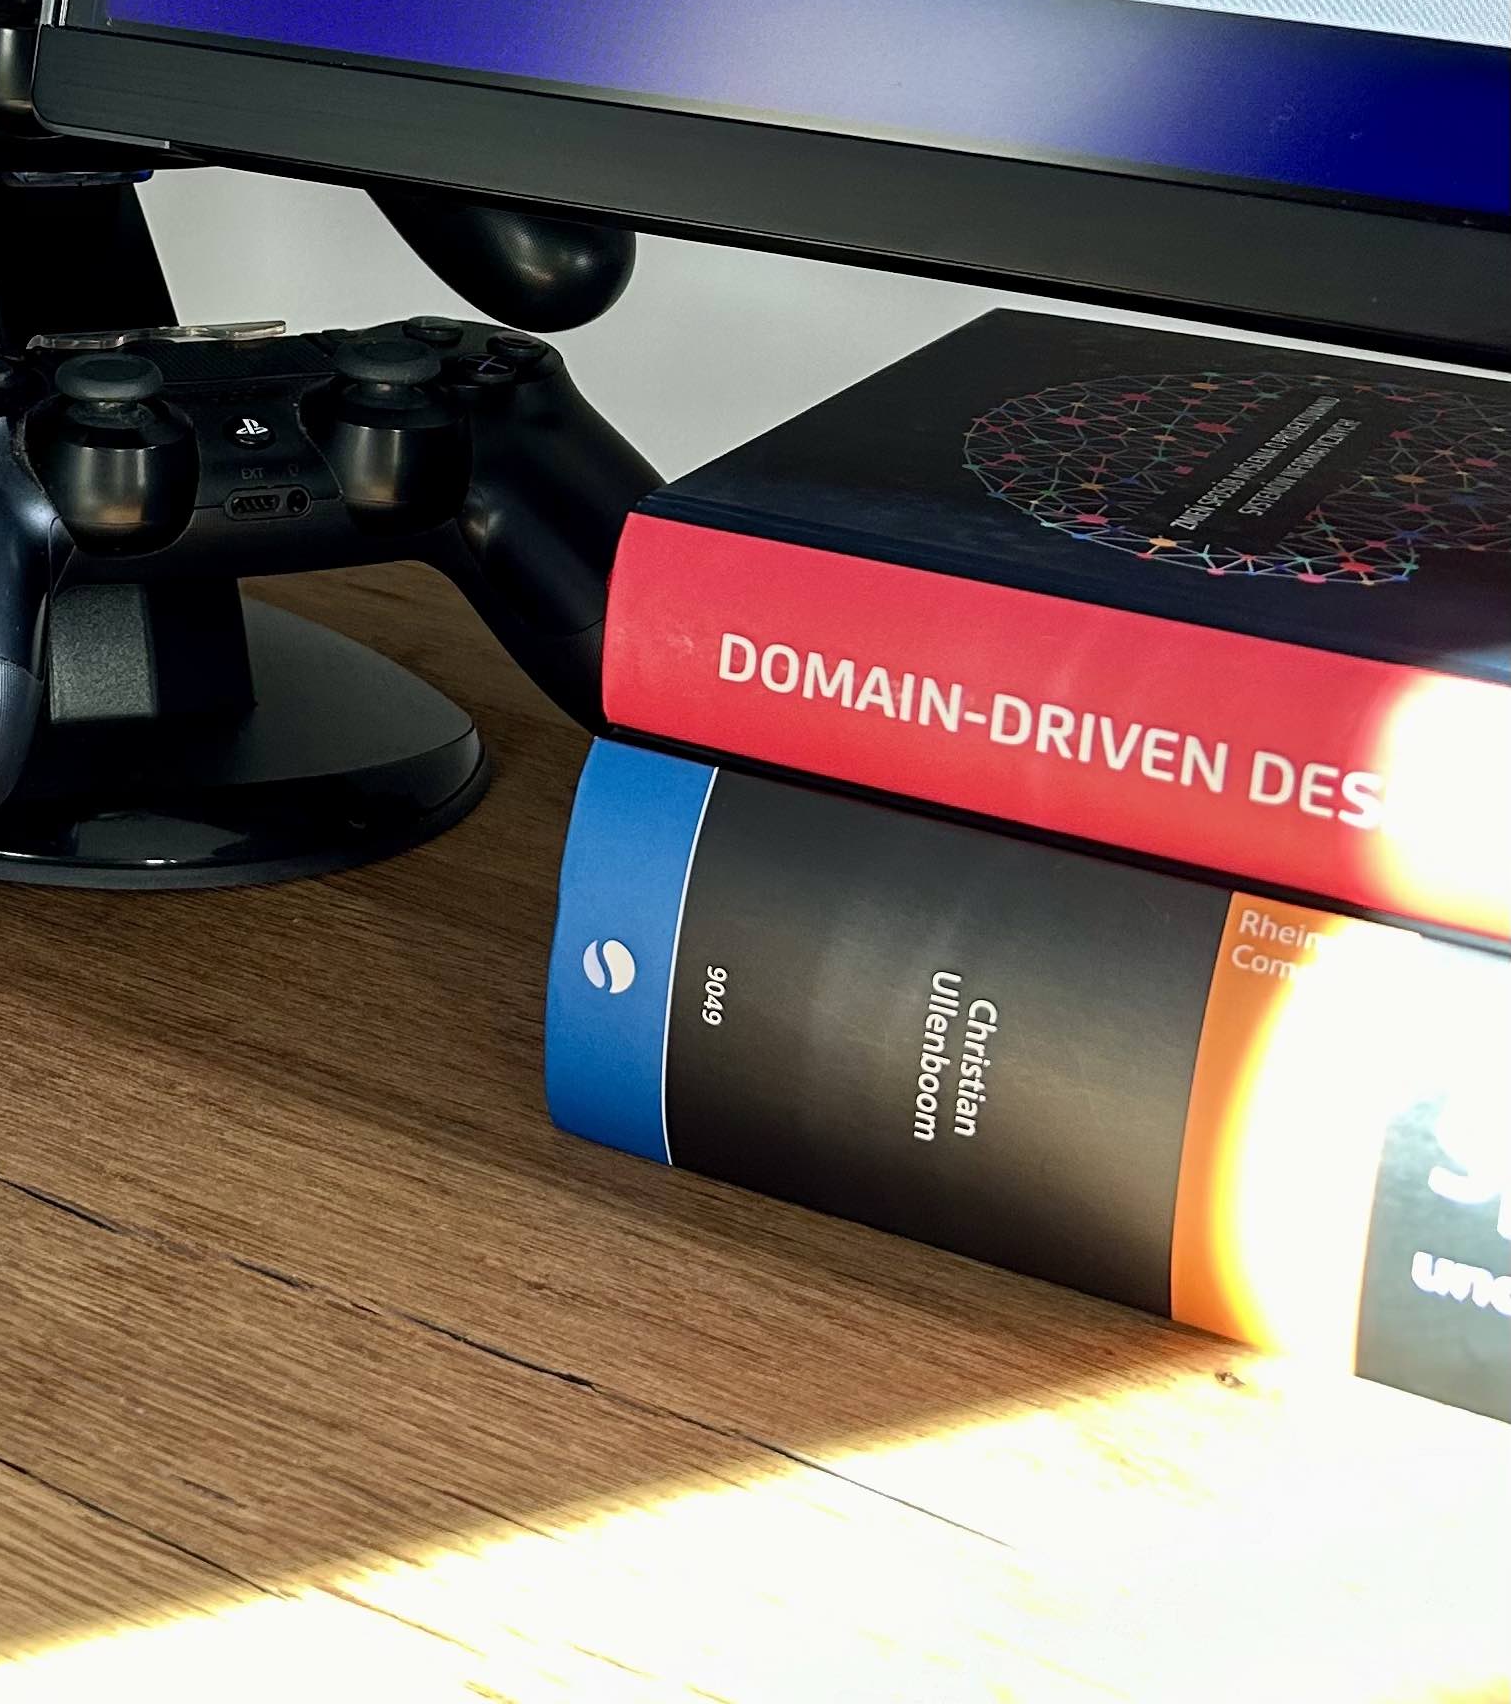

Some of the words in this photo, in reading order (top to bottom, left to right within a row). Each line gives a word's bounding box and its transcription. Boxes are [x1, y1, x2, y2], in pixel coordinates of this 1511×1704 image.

[1196, 477, 1246, 507] SPOSÓB
[718, 632, 1229, 793] DOMAIN-DRIVEN
[701, 965, 728, 1026] 9049
[913, 970, 962, 1142] Ullenboom
[953, 998, 999, 1137] Christian
